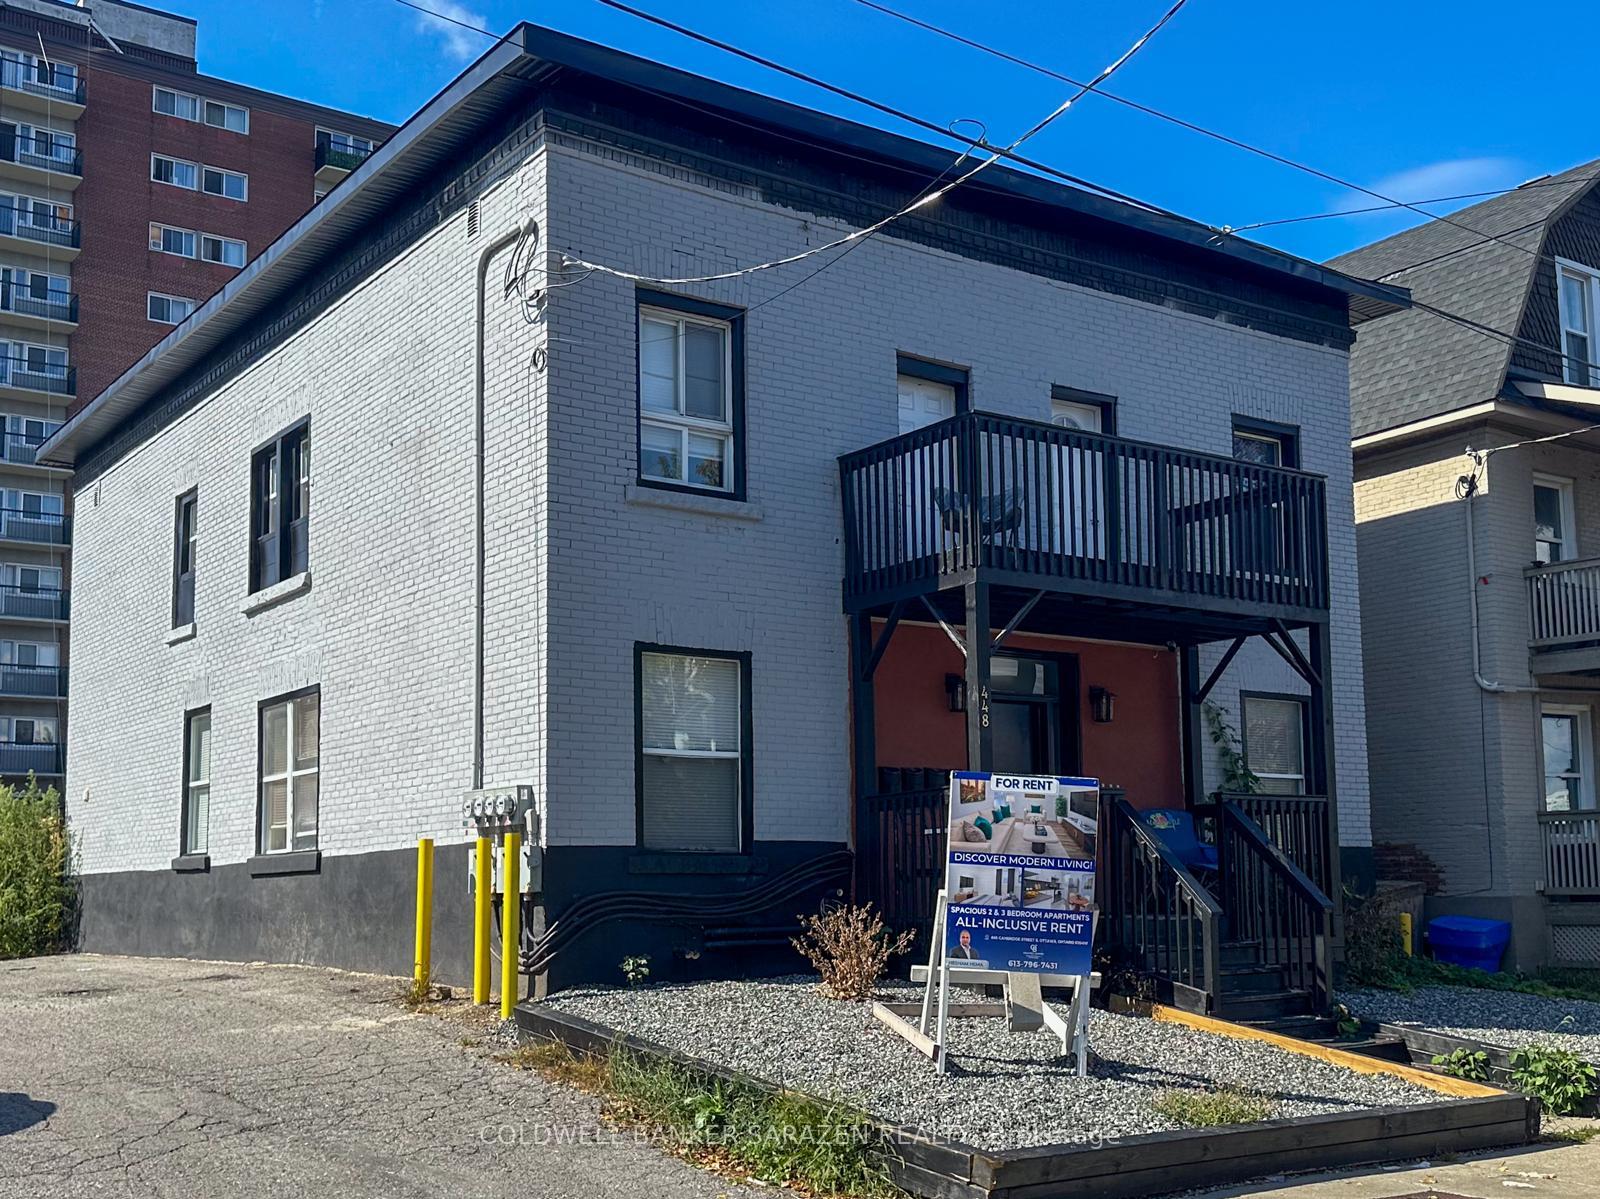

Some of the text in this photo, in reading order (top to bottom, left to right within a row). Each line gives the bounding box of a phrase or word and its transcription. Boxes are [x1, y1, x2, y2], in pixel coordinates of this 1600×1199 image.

[981, 685, 989, 727] 448
[995, 777, 1054, 791] FOR RENT
[954, 852, 1093, 870] DISCOVER MODERN LIVING!
[950, 906, 987, 915] SPACIOUS
[994, 908, 1000, 916] &
[1006, 909, 1043, 919] BEDROOM
[1043, 912, 1090, 922] APARTMENTS
[955, 916, 1084, 934] ALL-INCLUSIVE RENT
[1008, 960, 1058, 969] 613-796-7431
